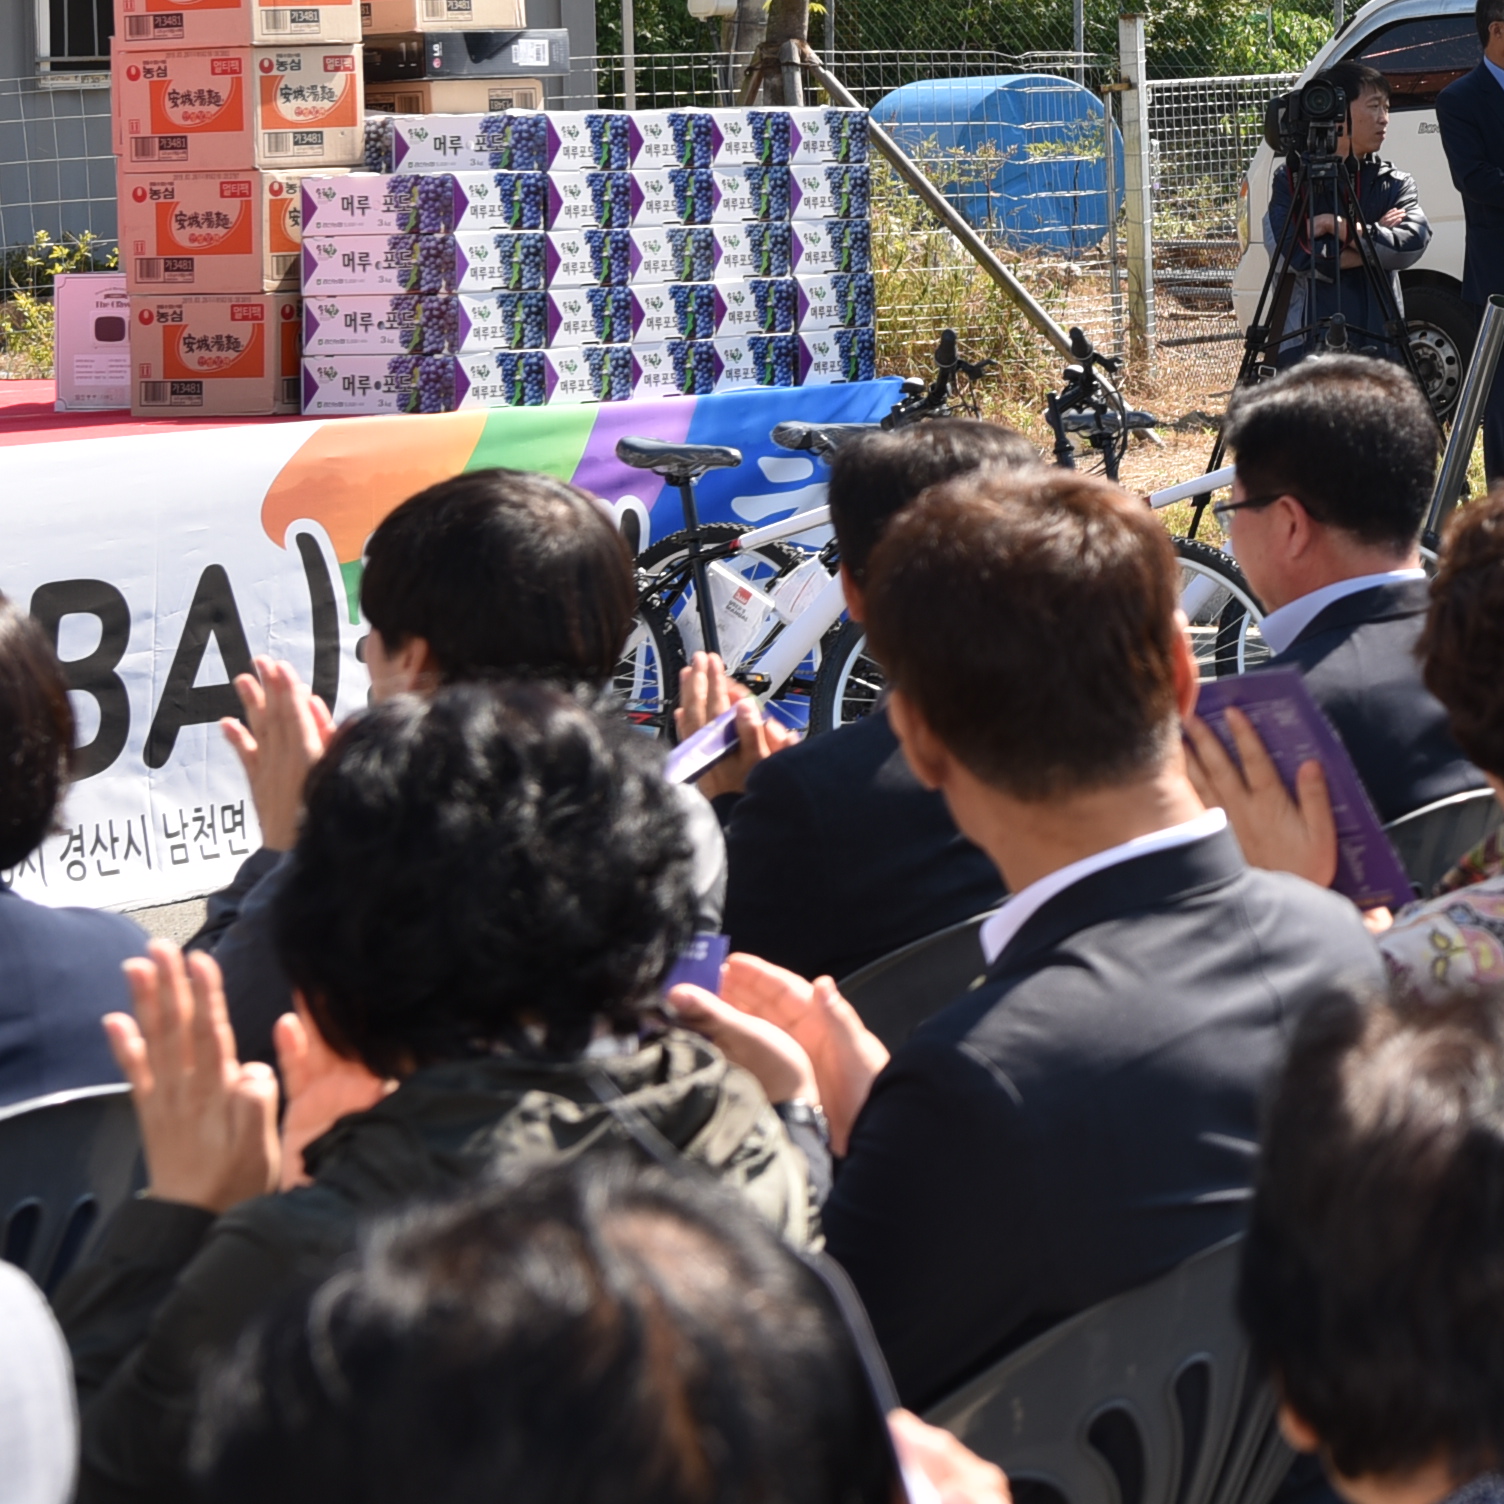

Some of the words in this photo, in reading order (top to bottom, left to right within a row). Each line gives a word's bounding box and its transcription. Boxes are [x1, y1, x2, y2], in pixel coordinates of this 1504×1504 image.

[212, 58, 240, 73] 멀티팩
[275, 58, 301, 71] 농심
[325, 56, 354, 70] 멀티팩
[142, 65, 168, 79] 농심
[433, 134, 463, 156] 머루
[148, 186, 175, 200] 농심
[221, 182, 250, 197] 멀티팩
[285, 181, 300, 195] 농
[341, 194, 371, 216] 머루
[342, 250, 372, 272] 머루
[156, 309, 184, 323] 농심
[232, 305, 262, 320] 멀티팩
[344, 311, 374, 333] 머루
[342, 374, 372, 396] 머루
[59, 814, 152, 882] 경산시
[162, 799, 250, 865] 남천면
